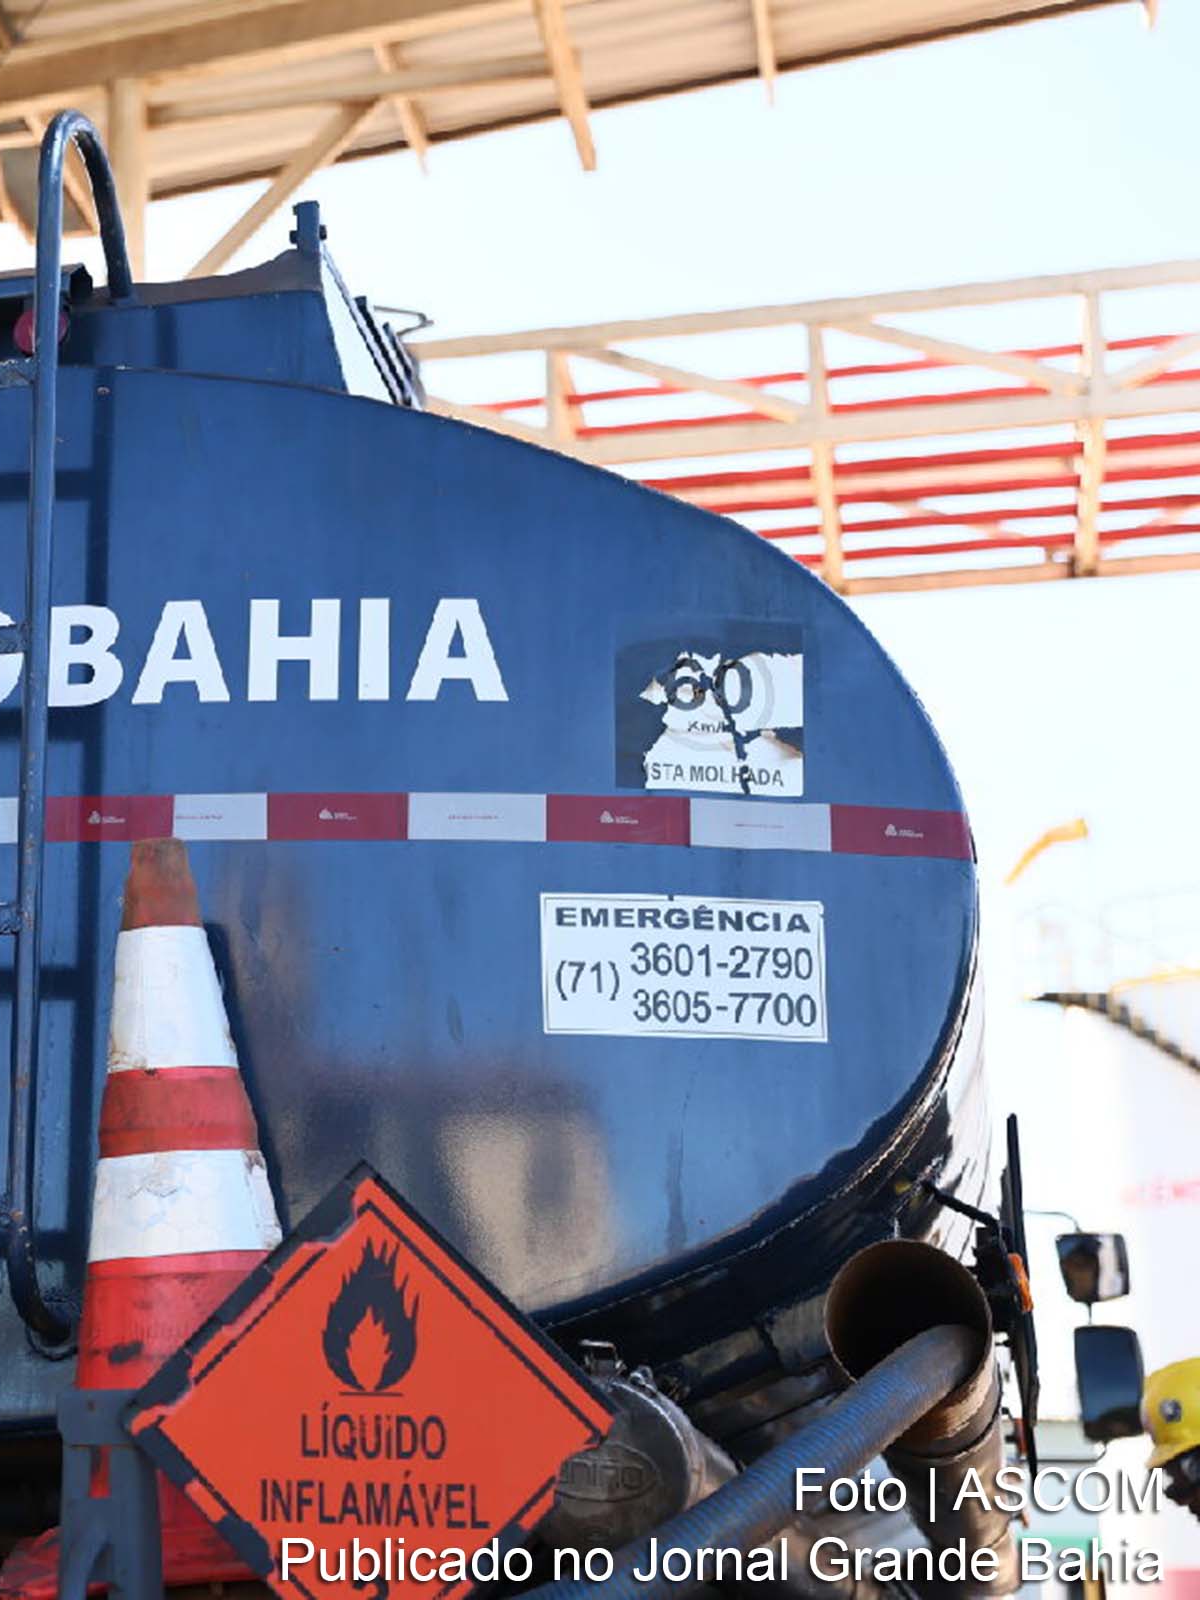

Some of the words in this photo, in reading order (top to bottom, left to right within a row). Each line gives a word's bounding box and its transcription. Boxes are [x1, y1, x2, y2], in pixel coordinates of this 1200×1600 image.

[665, 657, 753, 711] 60
[555, 905, 811, 933] EMERGÊNCIA
[555, 960, 621, 1001] (71)
[630, 942, 814, 980] 3601-2790
[633, 989, 818, 1027] 3605-7700
[259, 1470, 491, 1530] INFLAMÁVEL
